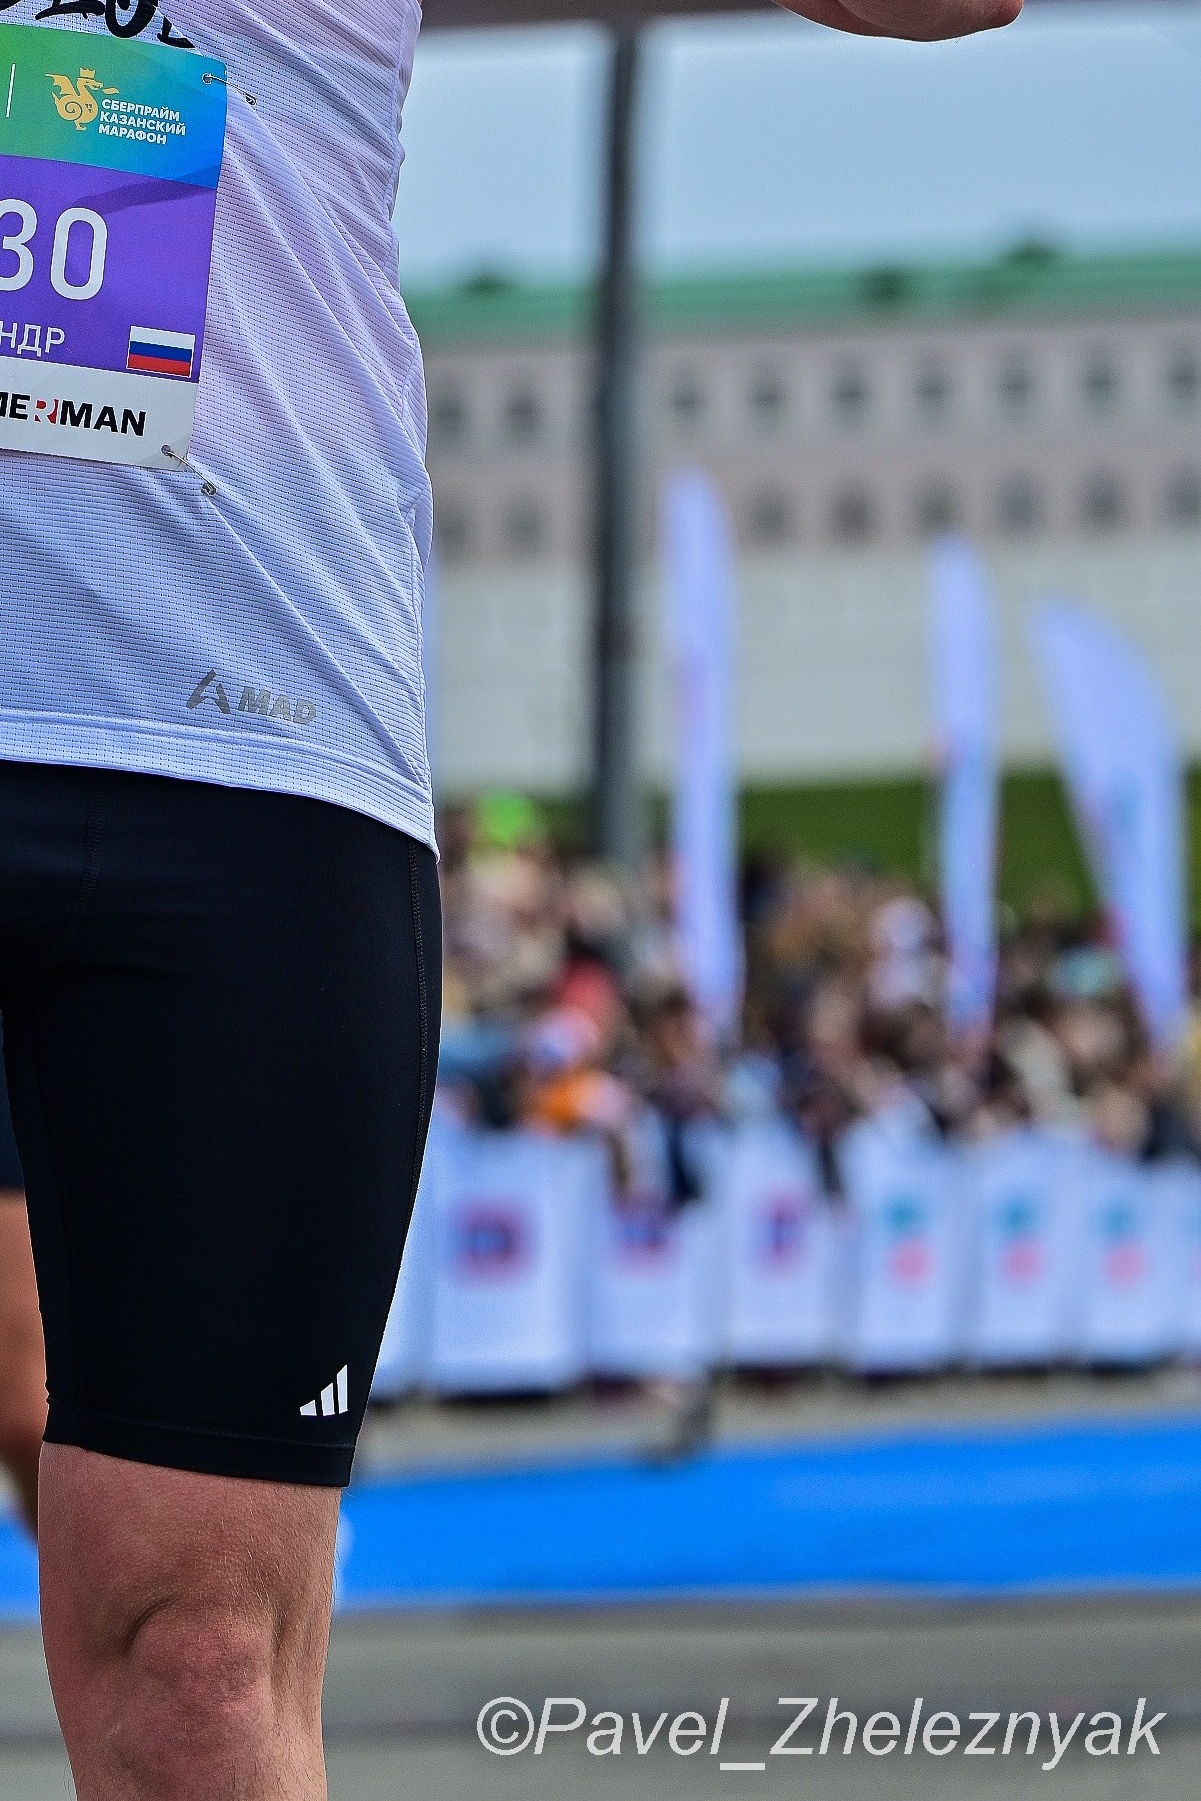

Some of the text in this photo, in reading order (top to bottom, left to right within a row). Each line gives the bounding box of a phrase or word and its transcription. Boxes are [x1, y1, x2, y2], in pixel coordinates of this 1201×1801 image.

[101, 98, 180, 122] СБЕРПРАЙМ
[98, 123, 167, 145] МАРАФОН
[100, 111, 187, 136] КАЗАНСКИЙ
